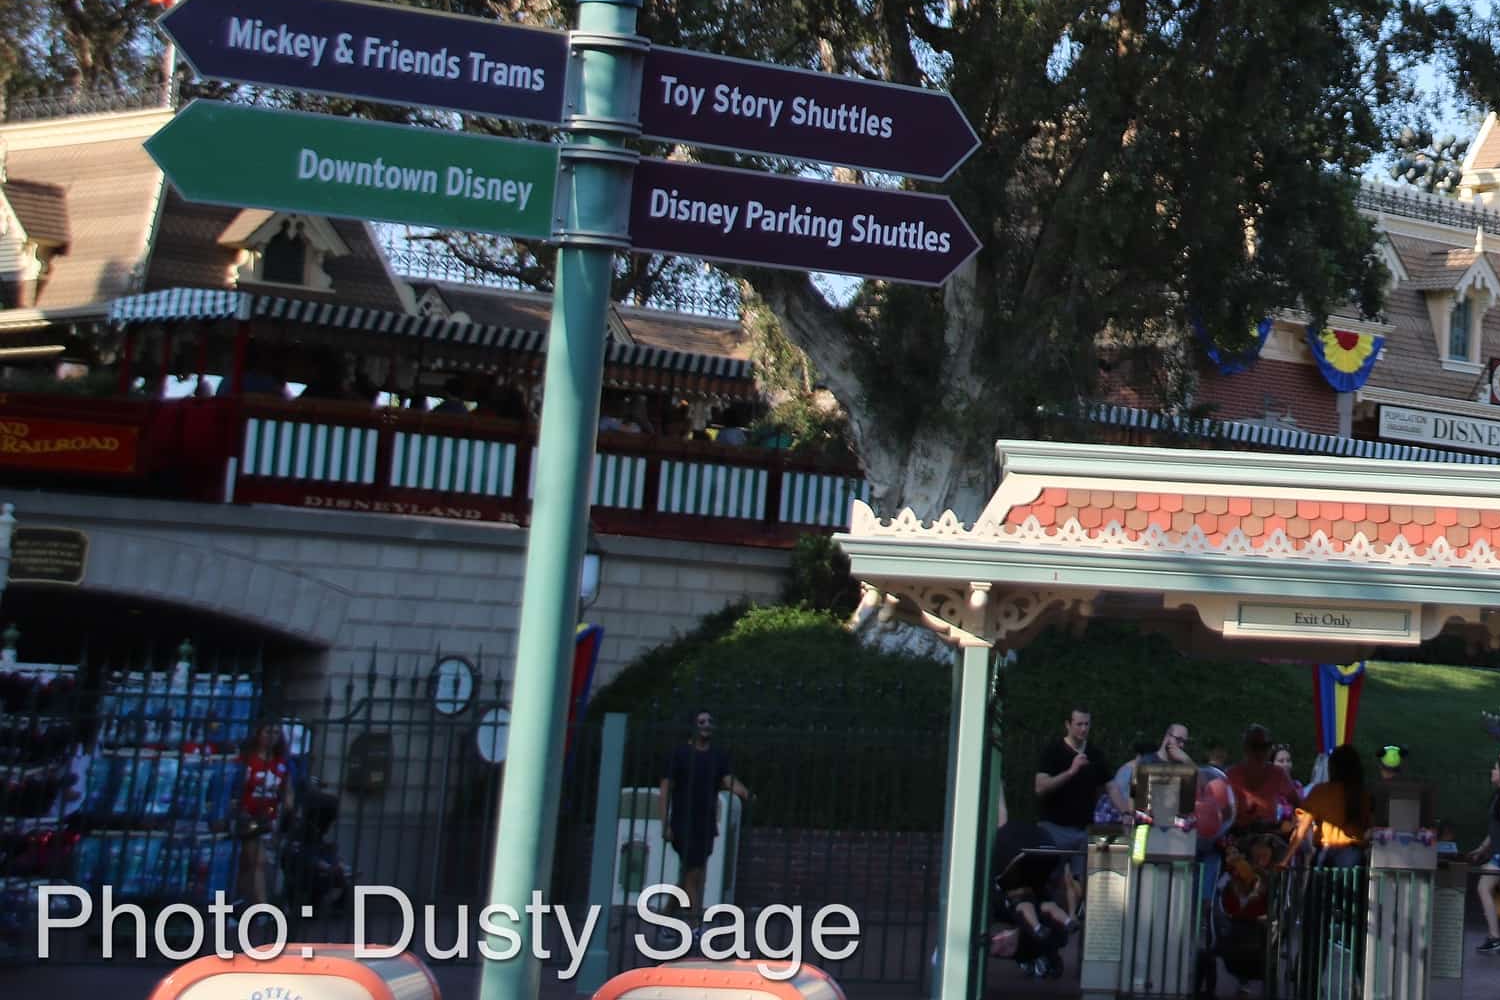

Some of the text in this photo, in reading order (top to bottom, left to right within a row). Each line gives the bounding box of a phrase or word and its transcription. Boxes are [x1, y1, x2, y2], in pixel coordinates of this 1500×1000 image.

[228, 16, 546, 92] Mickey & Friends Trams
[660, 75, 894, 139] Toy Story Shuttles
[299, 148, 533, 212] Downtown Disney
[650, 188, 951, 253] Disney Parking Shuttles
[304, 495, 481, 519] DISNEYLAND
[1295, 612, 1352, 629] Exit Only
